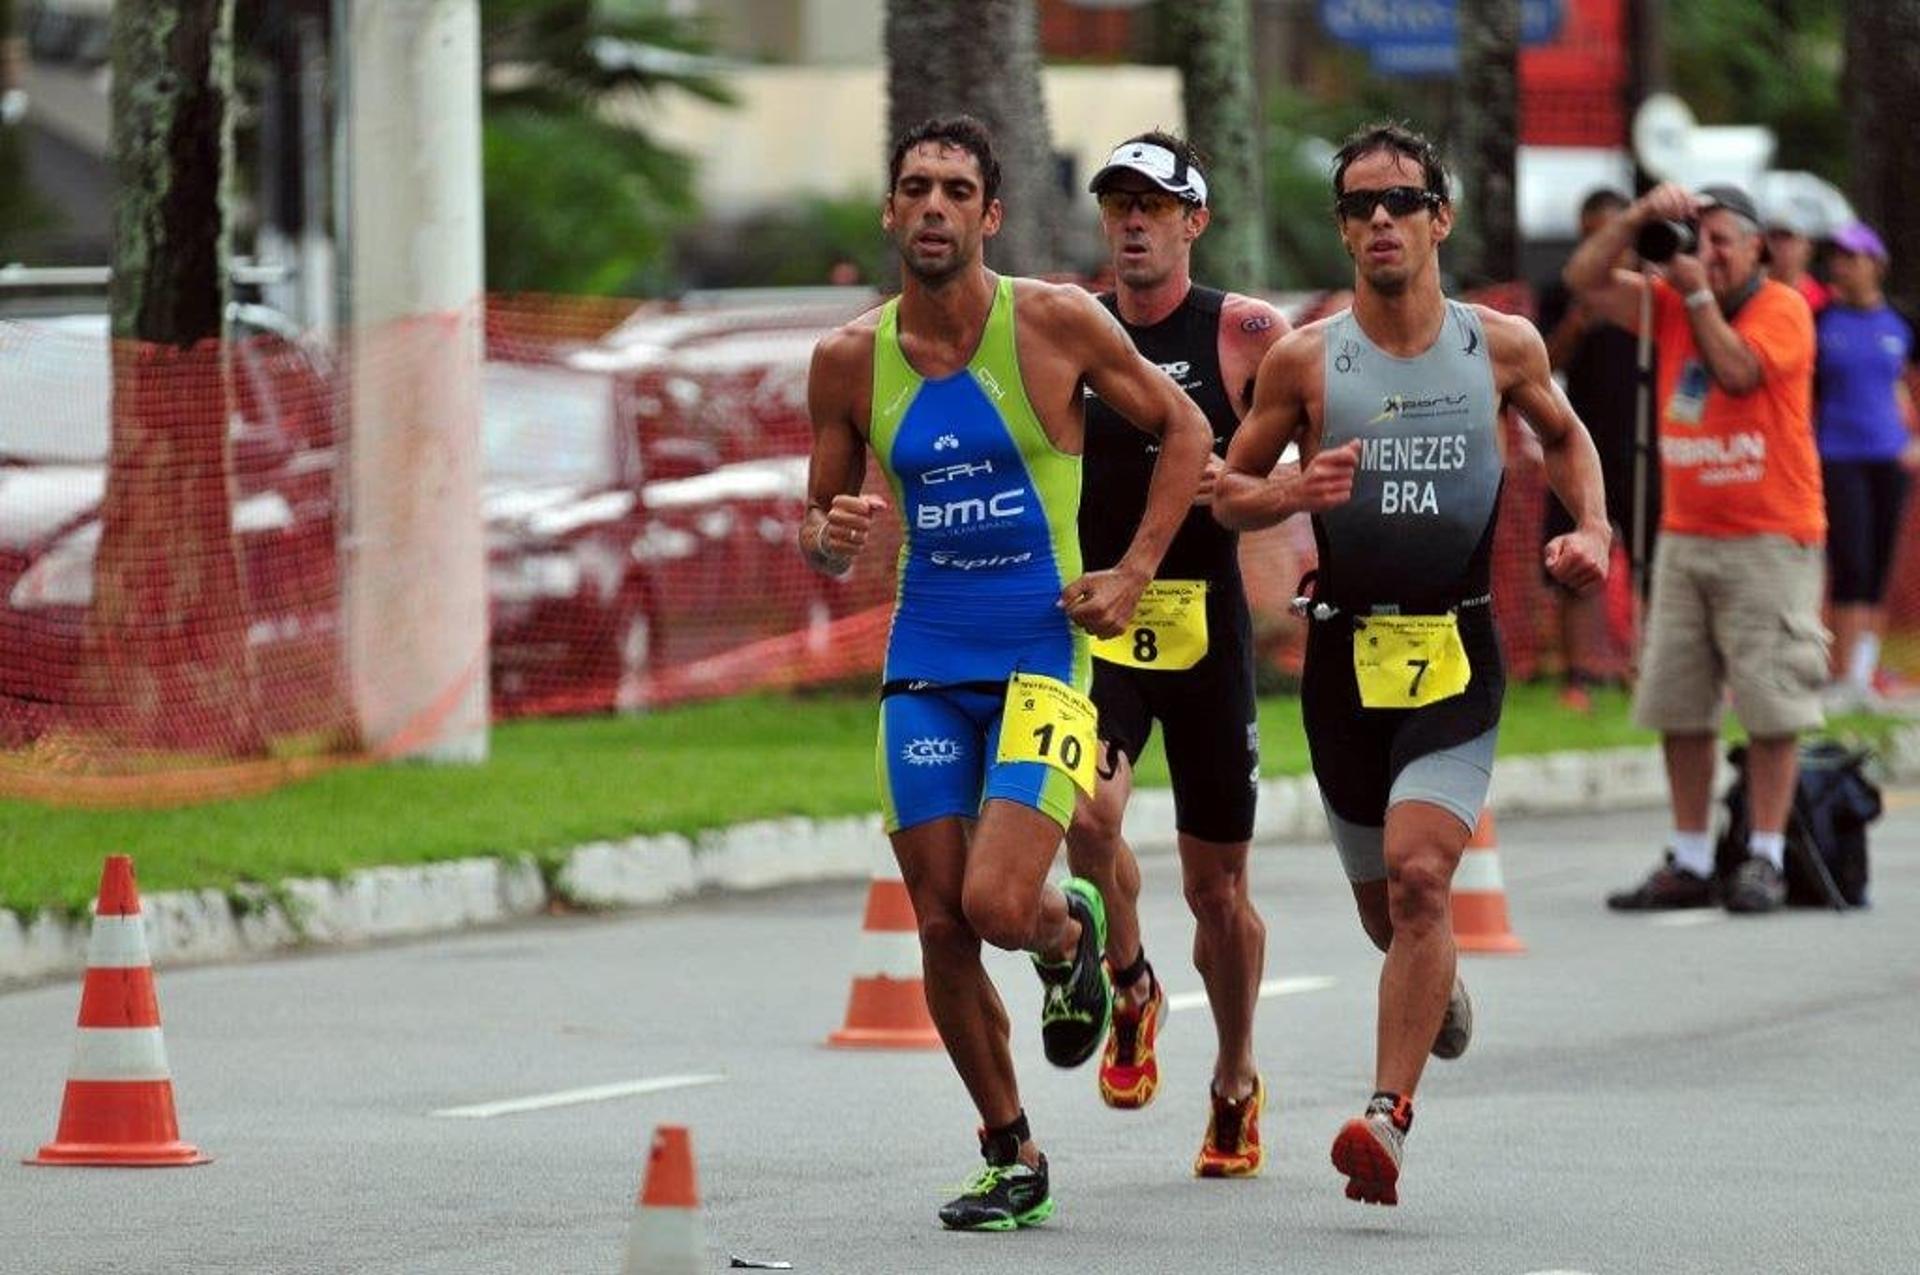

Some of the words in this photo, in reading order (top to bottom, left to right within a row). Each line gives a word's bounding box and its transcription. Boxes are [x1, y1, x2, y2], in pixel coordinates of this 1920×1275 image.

[1361, 434, 1467, 471] MENEZES
[917, 488, 1025, 530] BMC
[1381, 480, 1439, 514] BRA
[1133, 628, 1158, 662] 8
[1407, 659, 1430, 697] 7
[1033, 723, 1082, 771] 10
